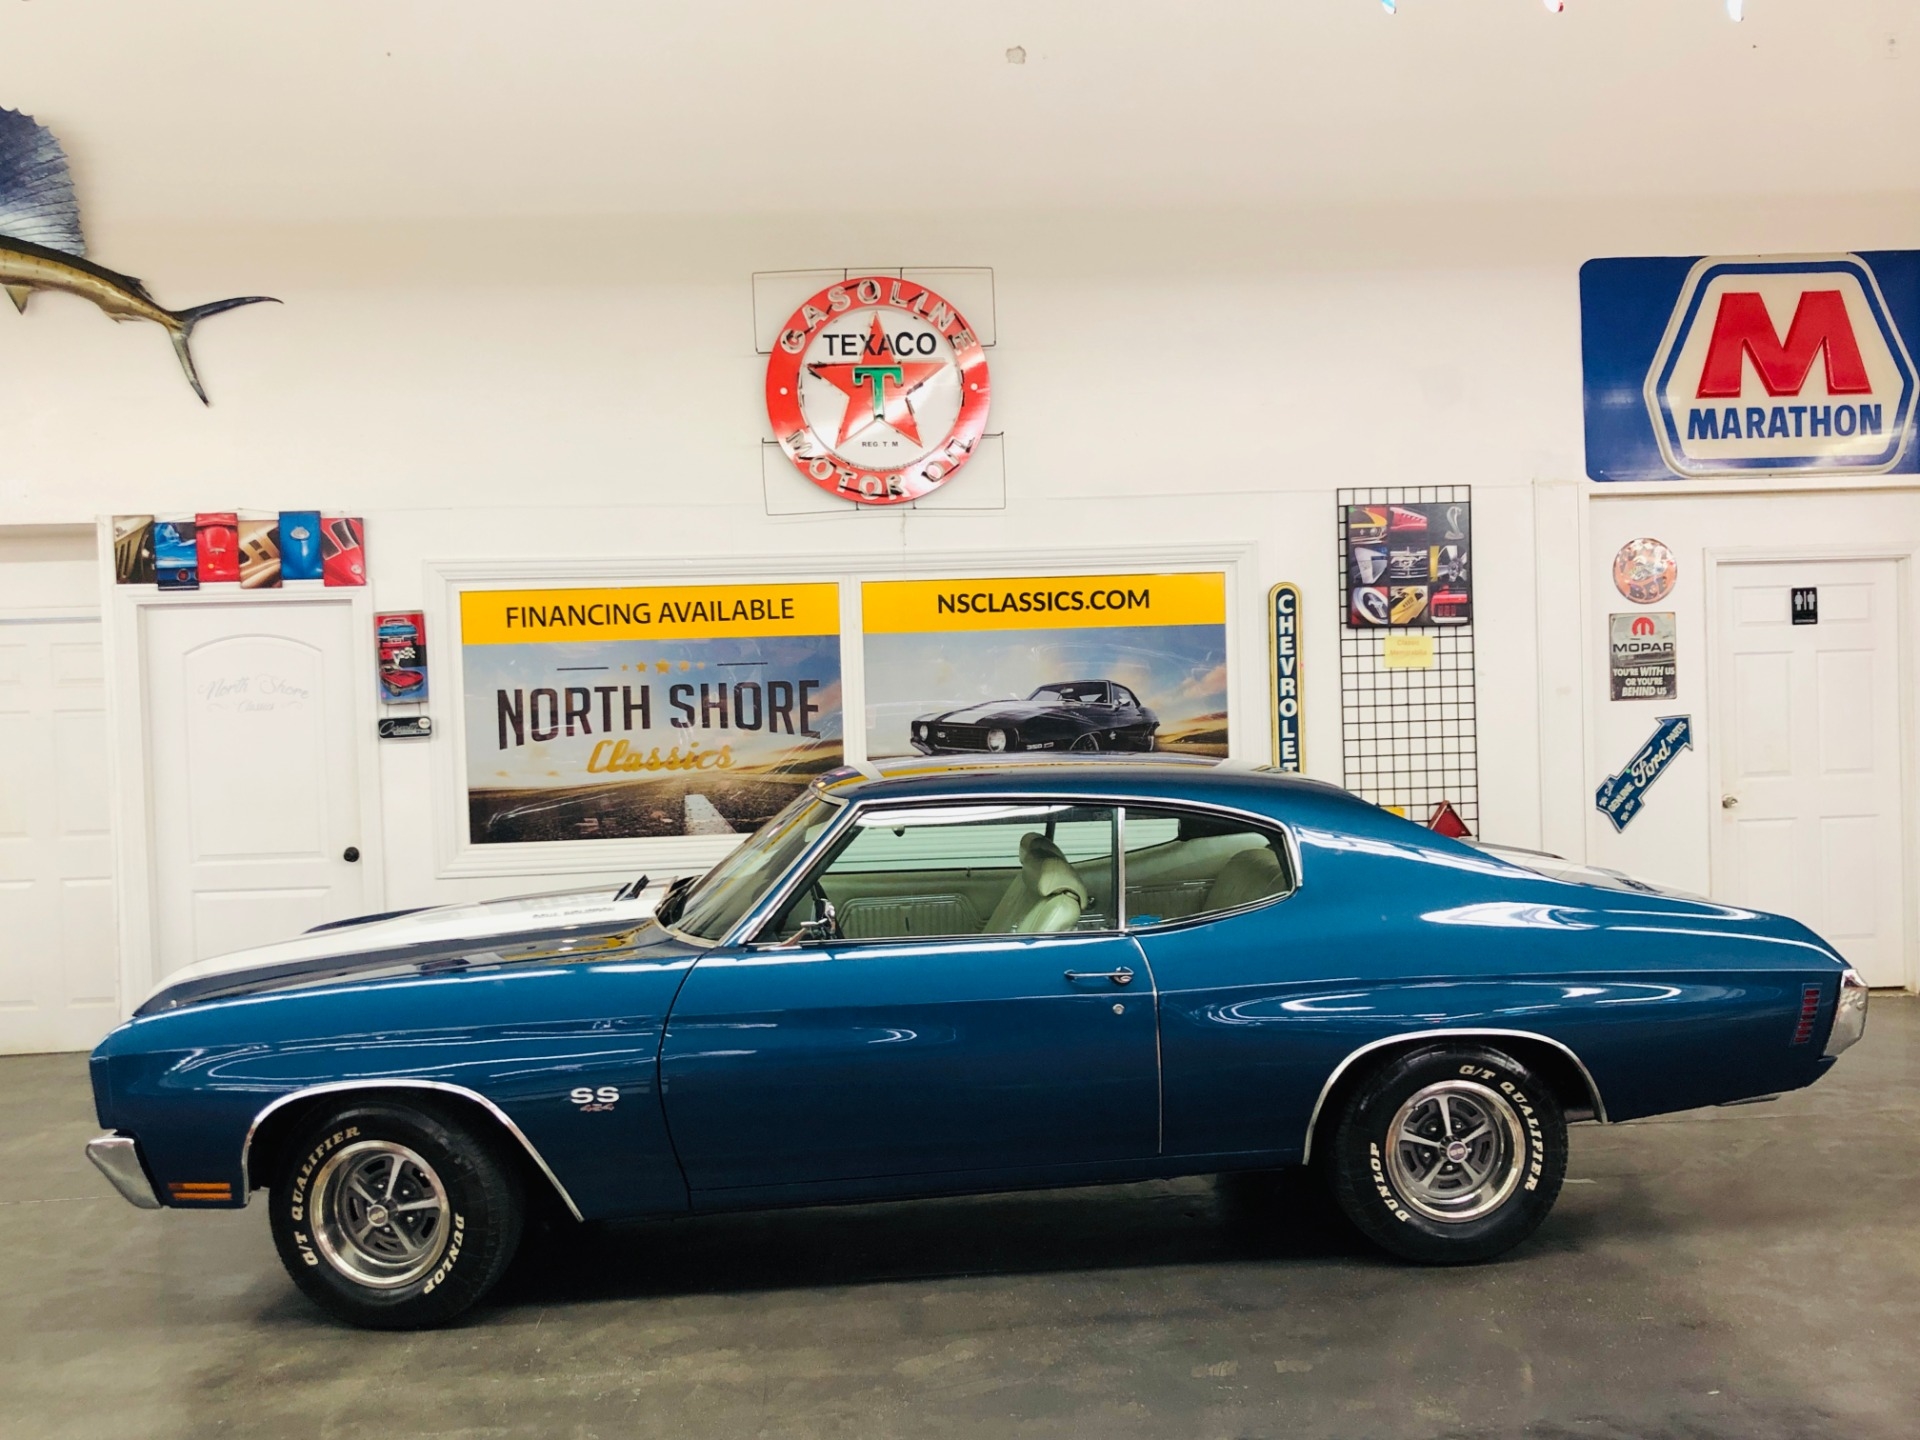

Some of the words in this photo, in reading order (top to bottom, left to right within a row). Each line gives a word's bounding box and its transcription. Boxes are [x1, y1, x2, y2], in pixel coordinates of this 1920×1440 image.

[781, 279, 976, 354] GASOLINE
[823, 332, 937, 356] TEXACO
[1695, 289, 1872, 399] M
[1687, 404, 1883, 440] MARATHON
[786, 429, 912, 500] MOTOR
[922, 436, 976, 483] OIL
[506, 603, 651, 628] FINANCING
[658, 598, 795, 624] AVAILABLE
[937, 589, 1151, 615] NSCLASSICS.COM
[1613, 642, 1674, 653] MOPAR
[1613, 668, 1639, 676] YOU'RE
[1640, 666, 1664, 676] WITH
[1665, 667, 1675, 675] US
[1625, 678, 1637, 686] OR
[1637, 677, 1663, 685] YOU'RE
[1622, 686, 1656, 697] BEHIND
[1657, 686, 1667, 695] US
[497, 685, 651, 750] NORTH
[669, 680, 820, 740] SHORE
[587, 739, 736, 774] Classics
[1608, 782, 1635, 812] GENUINE
[1631, 739, 1671, 787] Ford
[1666, 721, 1687, 743] PARTS
[570, 1086, 619, 1104] SS
[1459, 1065, 1495, 1080] G/T
[1500, 1082, 1543, 1191] QUALIFIER
[291, 1126, 360, 1221] QUALIFIER
[1370, 1142, 1411, 1222] DUNLOP
[294, 1231, 318, 1267] G/T
[423, 1213, 464, 1294] DUNLOP
